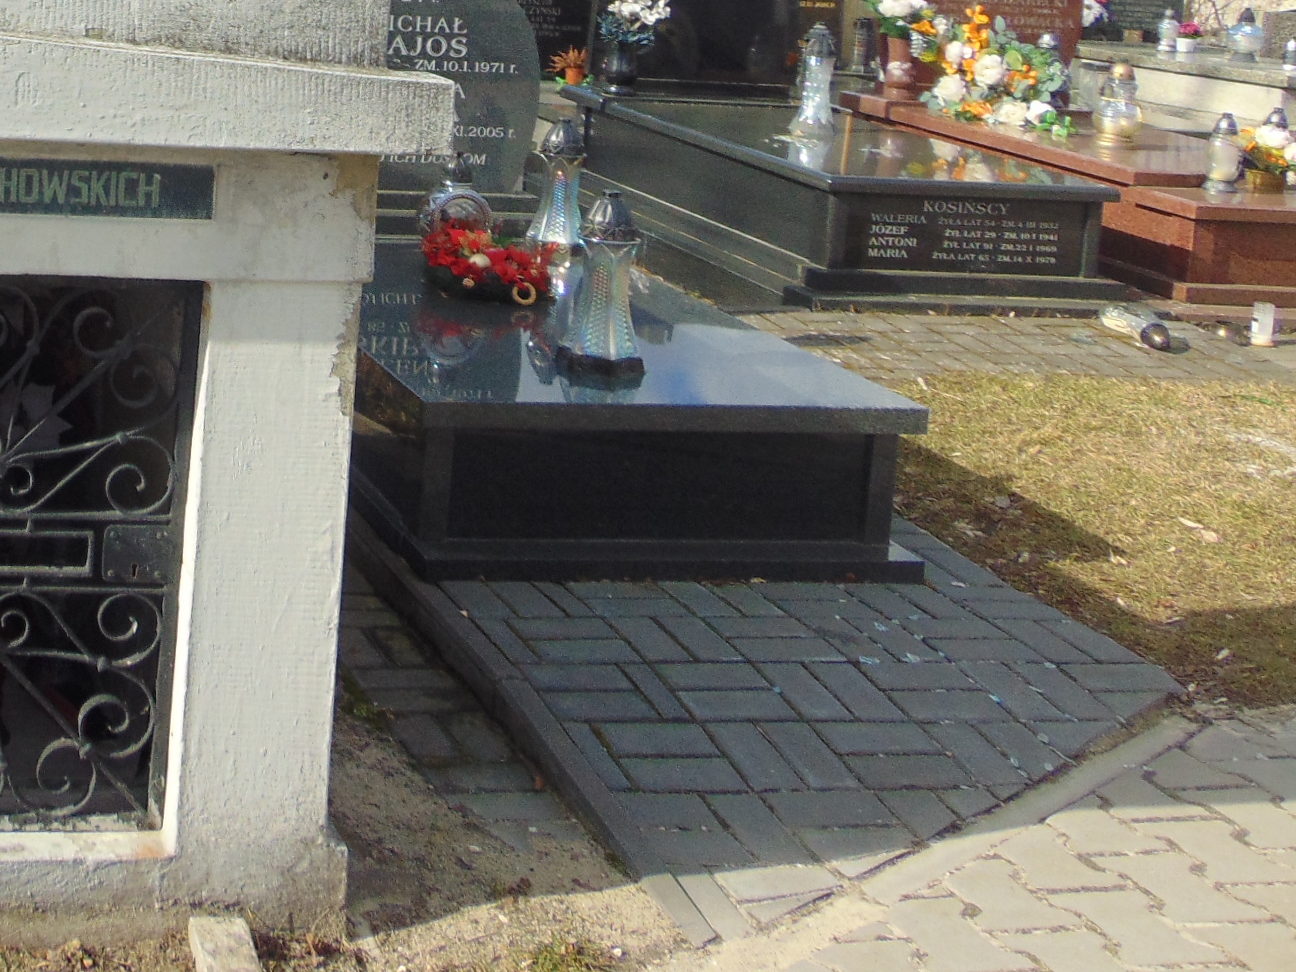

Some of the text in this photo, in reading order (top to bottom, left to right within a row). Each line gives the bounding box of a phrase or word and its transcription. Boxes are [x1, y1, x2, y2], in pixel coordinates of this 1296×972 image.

[388, 15, 467, 34] ICHAŁ
[387, 34, 468, 58] AJOS
[871, 213, 927, 224] WALERIA
[964, 218, 982, 226] LAT
[869, 222, 909, 234] JÓZEF
[964, 230, 982, 238] LAT
[868, 236, 918, 247] ANTONI
[963, 241, 981, 250] LAT
[867, 248, 908, 258] MARIA
[958, 253, 976, 261] LAT
